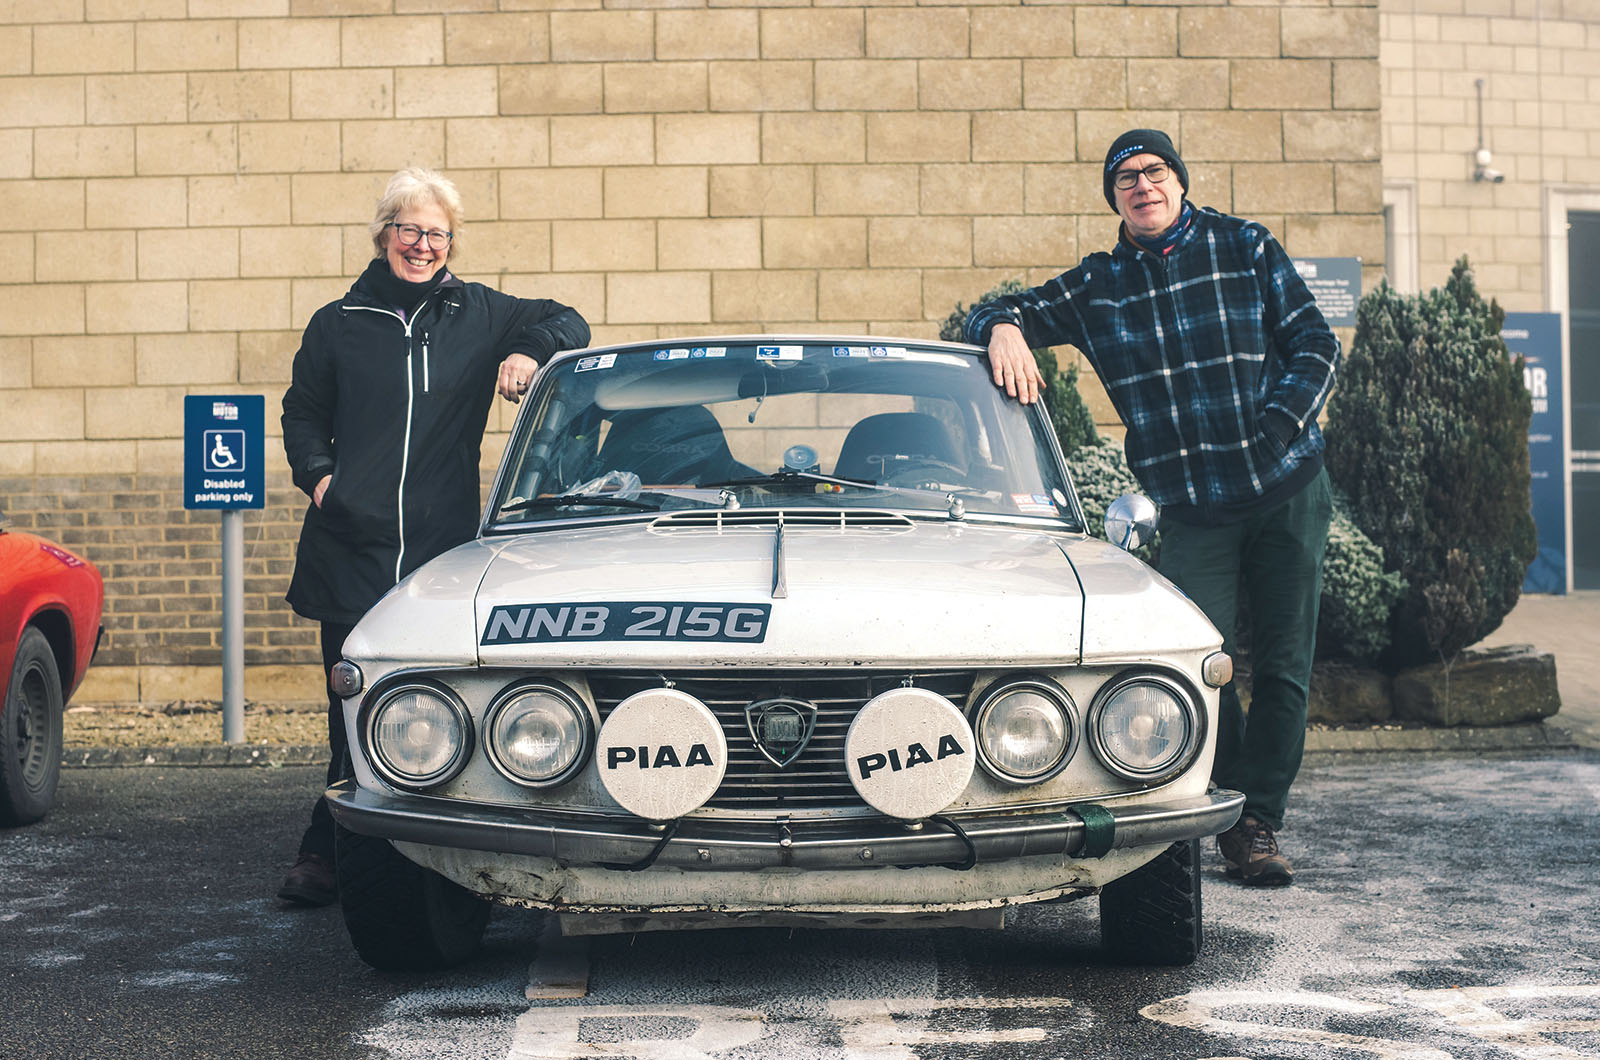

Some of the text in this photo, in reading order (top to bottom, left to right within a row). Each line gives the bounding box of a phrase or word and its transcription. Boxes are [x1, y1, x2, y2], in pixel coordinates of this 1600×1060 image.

[195, 491, 253, 503] parking only
[204, 479, 245, 489] Disabled
[486, 606, 765, 640] NNB 215G
[607, 743, 714, 770] PIAA
[857, 733, 965, 780] PIAA
